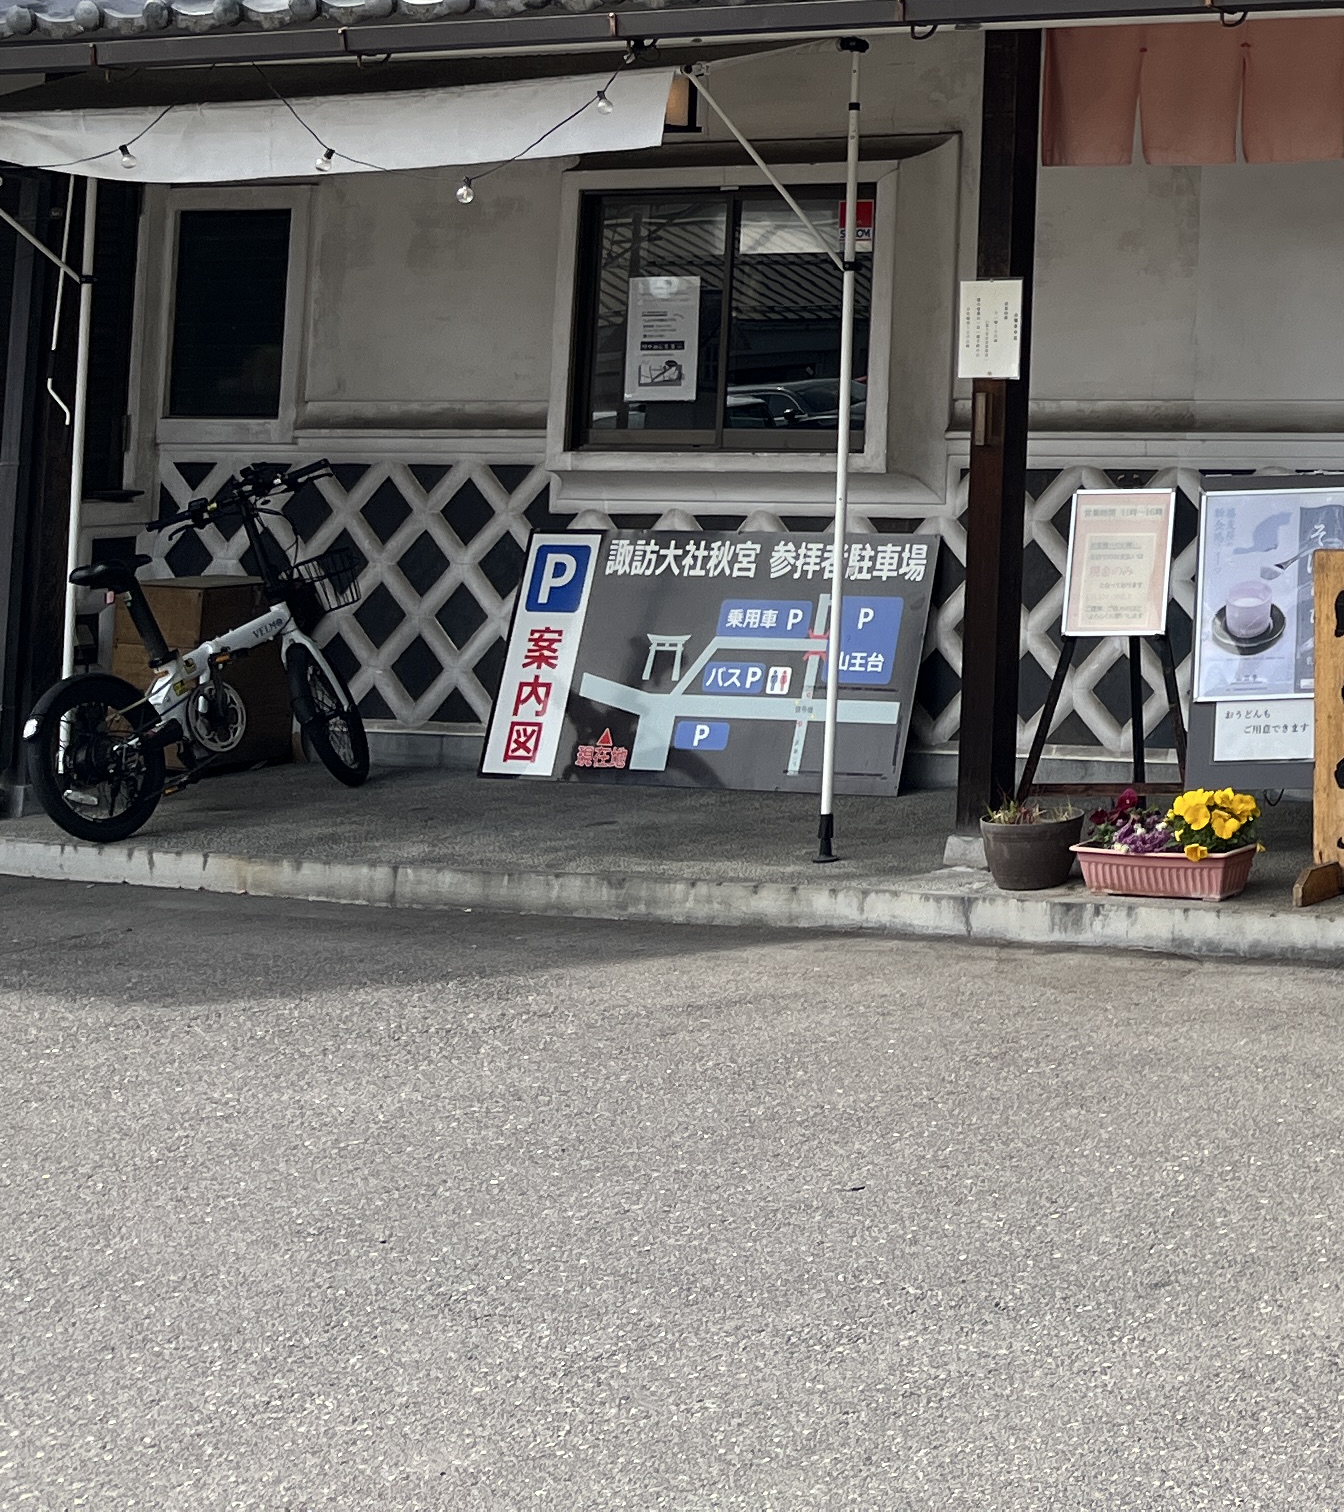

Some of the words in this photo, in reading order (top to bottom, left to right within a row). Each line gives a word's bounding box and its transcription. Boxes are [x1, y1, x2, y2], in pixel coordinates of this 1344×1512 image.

[840, 229, 870, 238] SOM
[605, 539, 761, 578] 諏訪大社秋宮
[769, 540, 928, 581] 参拝者駐車場
[537, 553, 577, 604] P
[726, 609, 778, 629] 乗用車
[786, 609, 803, 630] P
[857, 608, 874, 630] P
[838, 651, 884, 672] 山王台
[503, 627, 563, 763] 案内図
[1225, 709, 1271, 719] おうどんも
[693, 726, 710, 747] P
[1243, 723, 1309, 735] ご用意できます
[575, 745, 628, 769] 現在地
